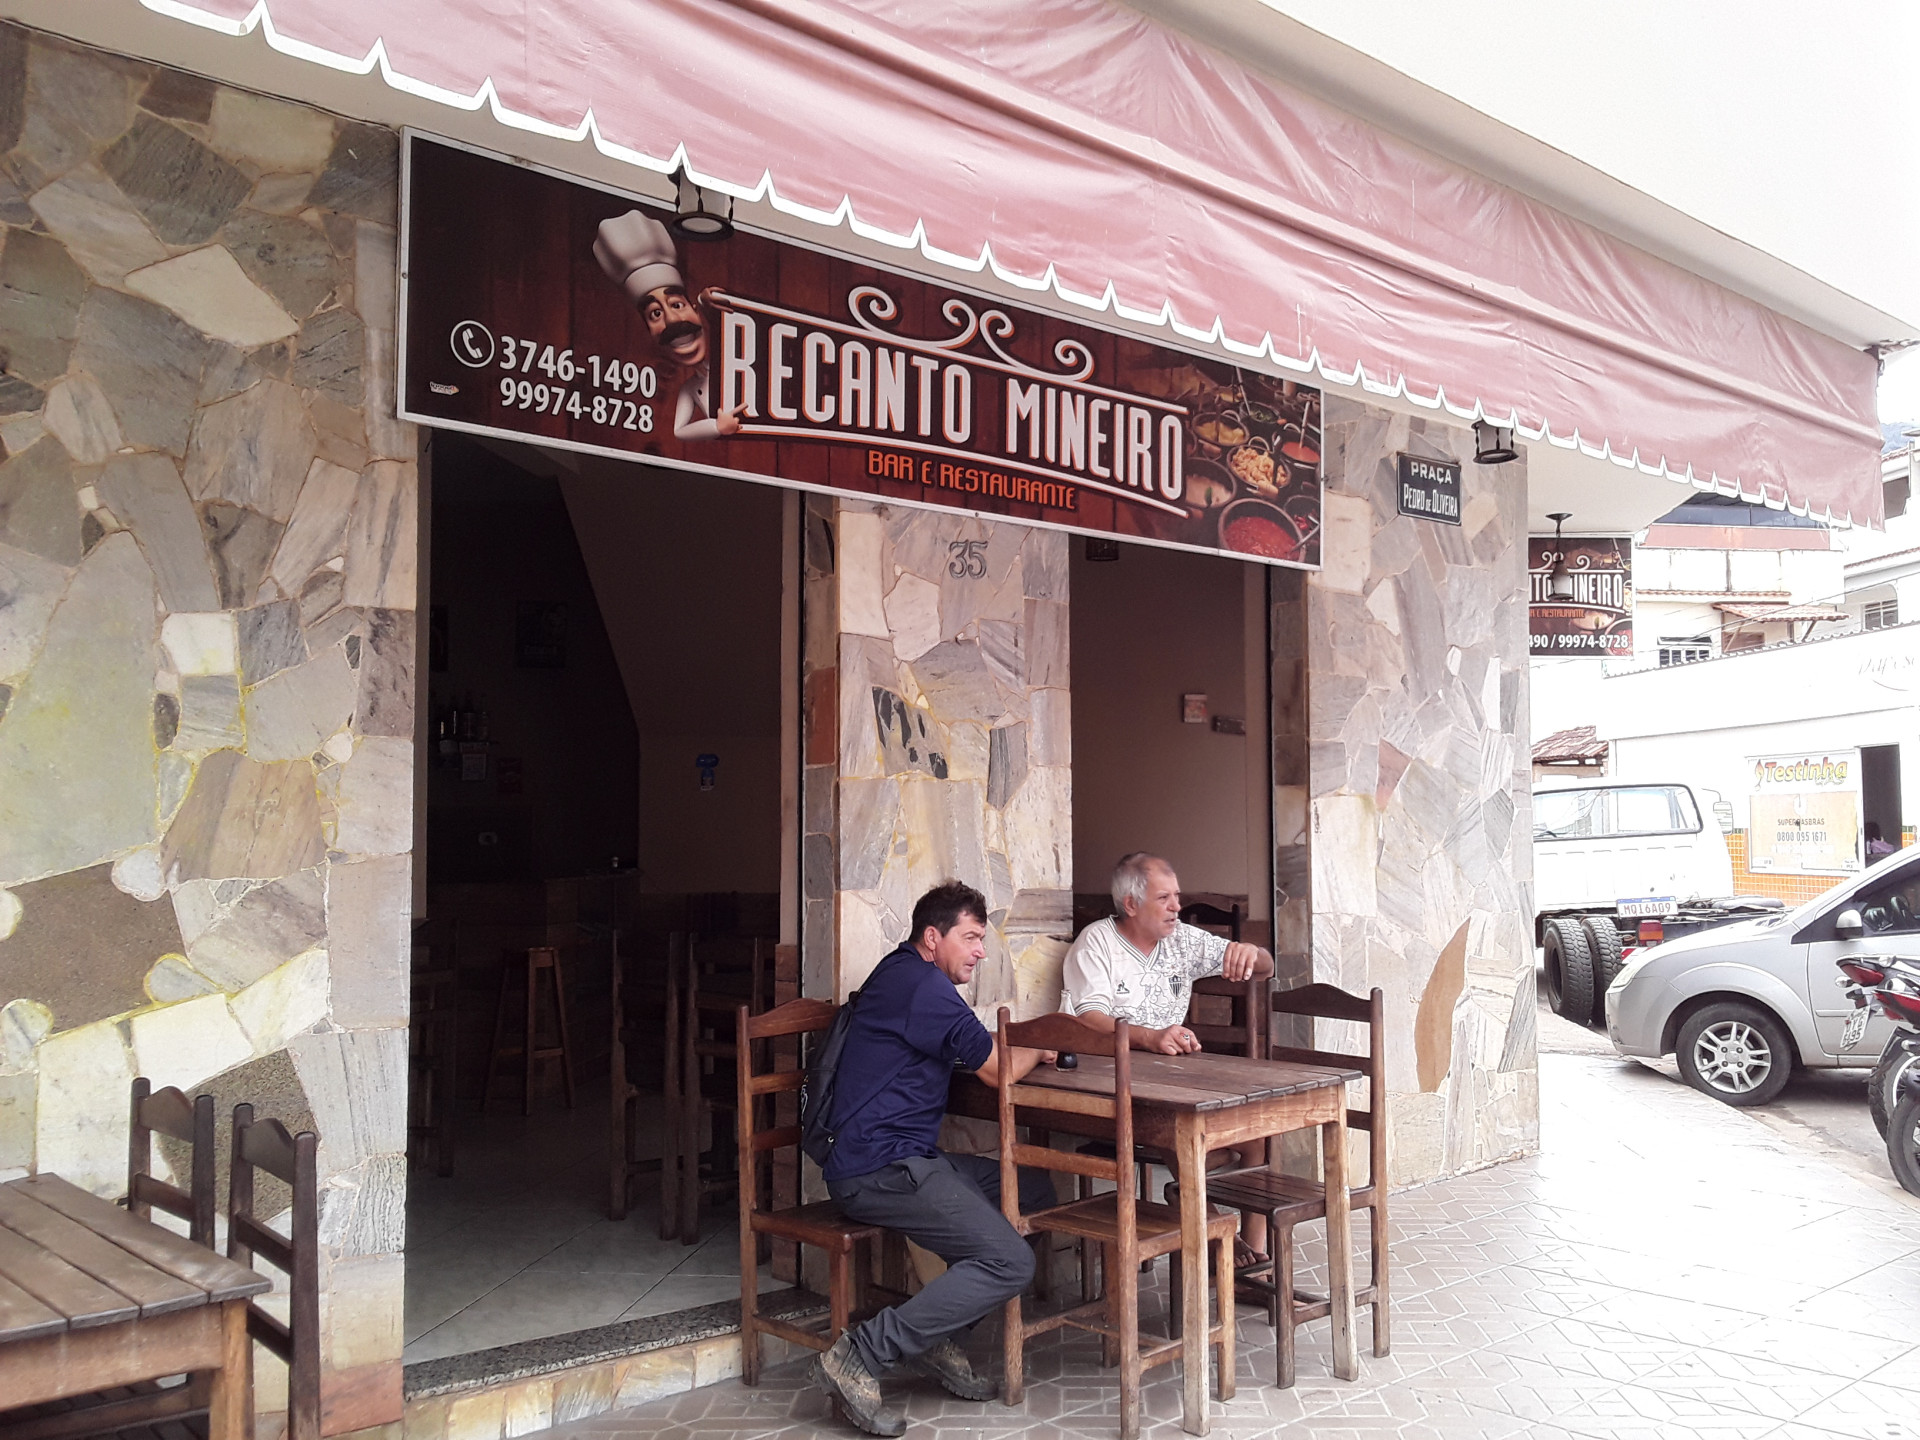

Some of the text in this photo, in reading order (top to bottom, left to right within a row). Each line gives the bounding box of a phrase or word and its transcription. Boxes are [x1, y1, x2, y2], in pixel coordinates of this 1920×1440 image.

[500, 336, 657, 398] 3746-1490
[500, 377, 654, 433] 99974-8728
[719, 309, 1184, 500] RECANTO MINEIRO
[868, 450, 1076, 509] BAR E RESTAURANTE
[1410, 461, 1453, 485] PRAÇA
[1403, 483, 1425, 511] PEDRO
[1431, 489, 1458, 517] OLIVEIRA
[947, 540, 989, 579] 35
[1568, 573, 1623, 608] INEIRO
[1558, 634, 1629, 649] 99974-8728
[1764, 756, 1848, 783] Testinha
